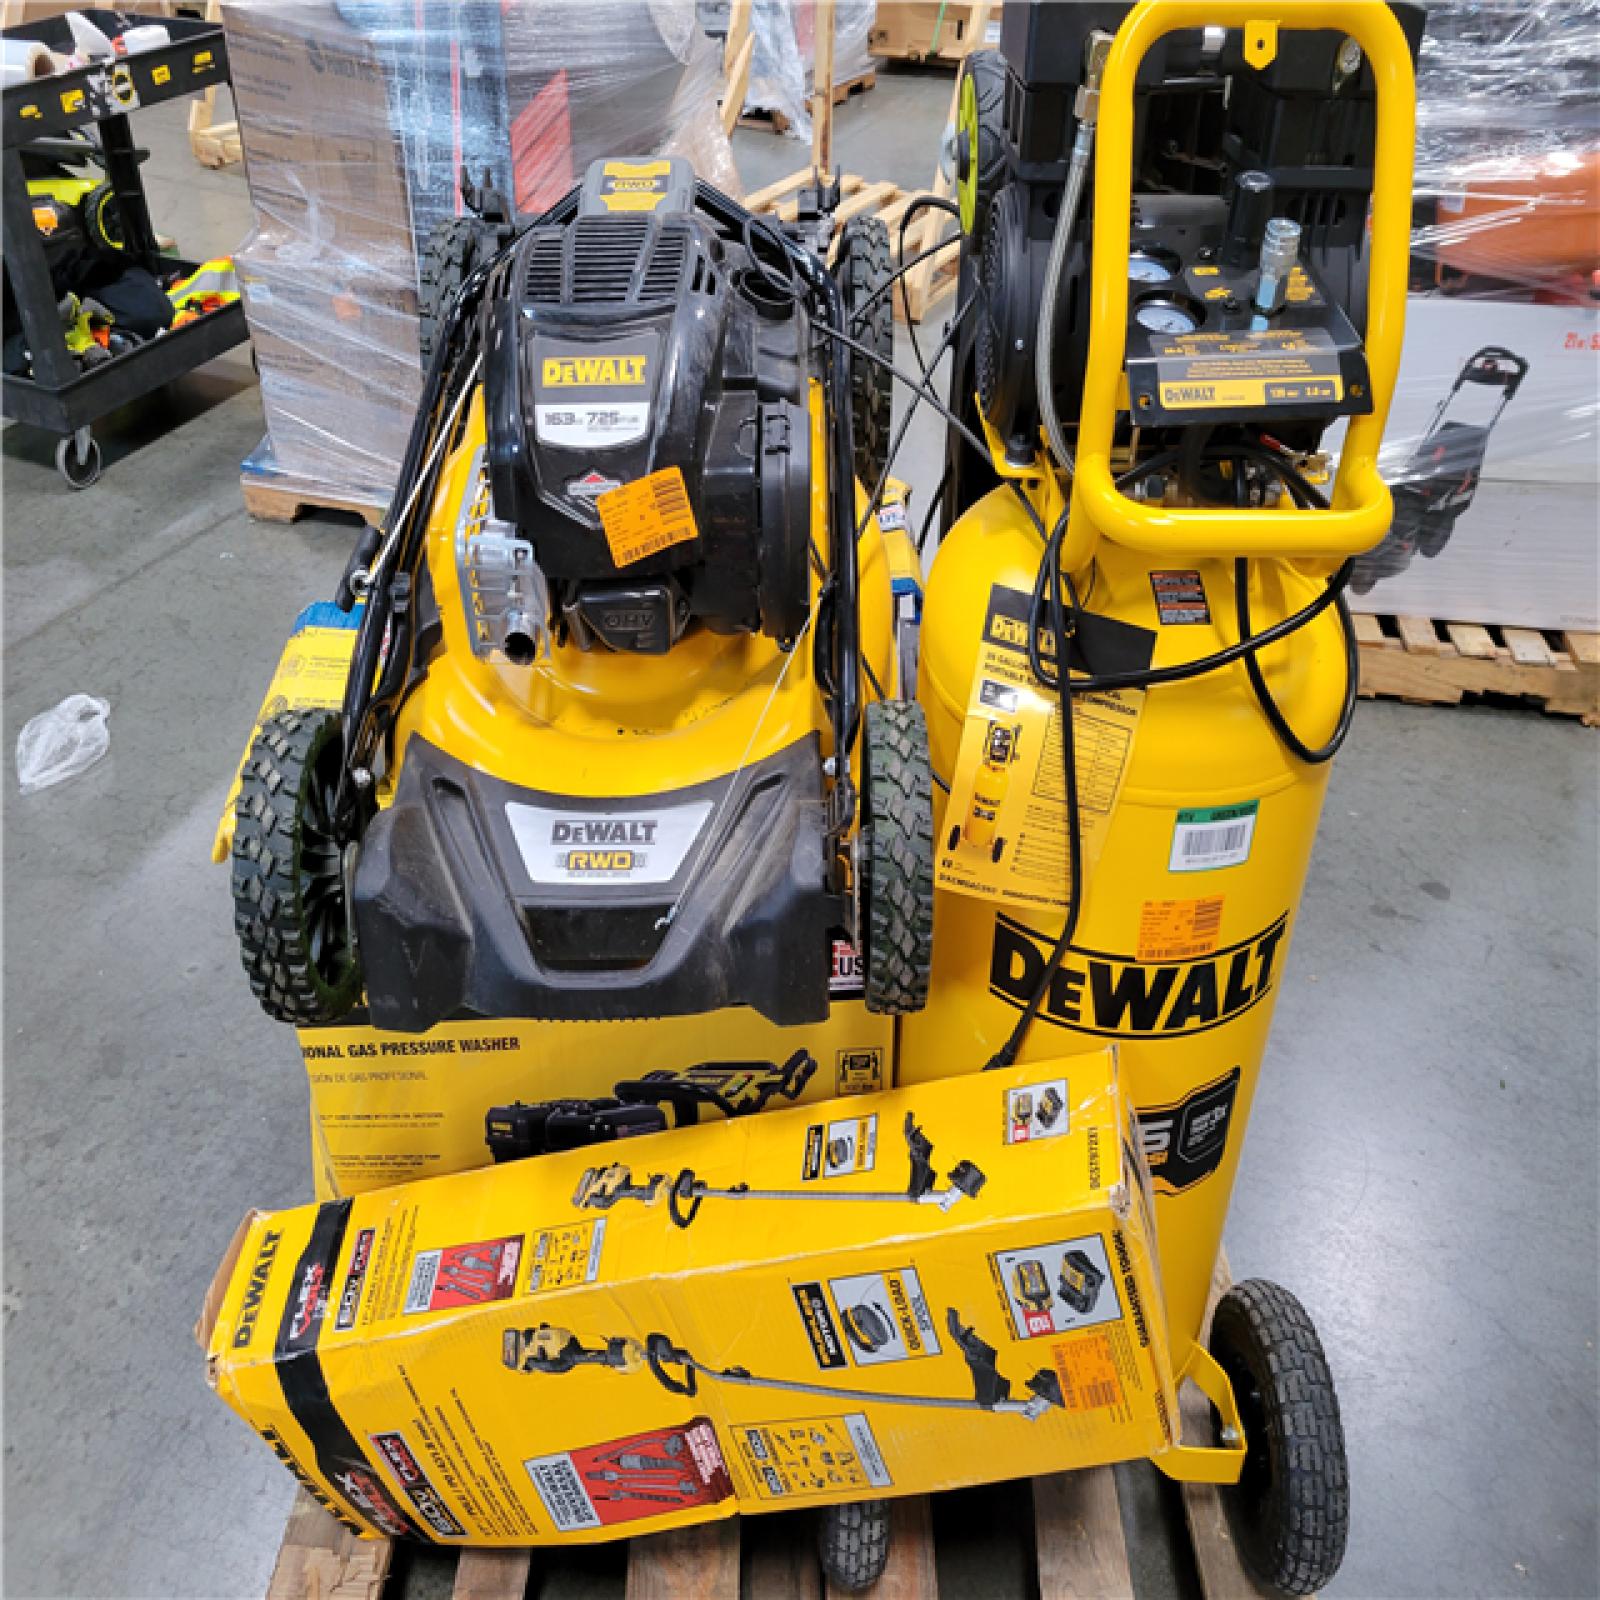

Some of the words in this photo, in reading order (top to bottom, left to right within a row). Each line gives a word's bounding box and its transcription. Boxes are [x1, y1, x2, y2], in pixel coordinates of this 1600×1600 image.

[543, 355, 647, 388] DEWALT
[551, 820, 658, 846] DEWALT
[567, 850, 634, 871] RWD
[990, 919, 1288, 1031] DEWALT
[348, 1043, 378, 1058] GAS
[380, 1039, 457, 1056] PRESSURE
[458, 1037, 521, 1053] WASHER
[232, 1229, 285, 1349] DEWALT
